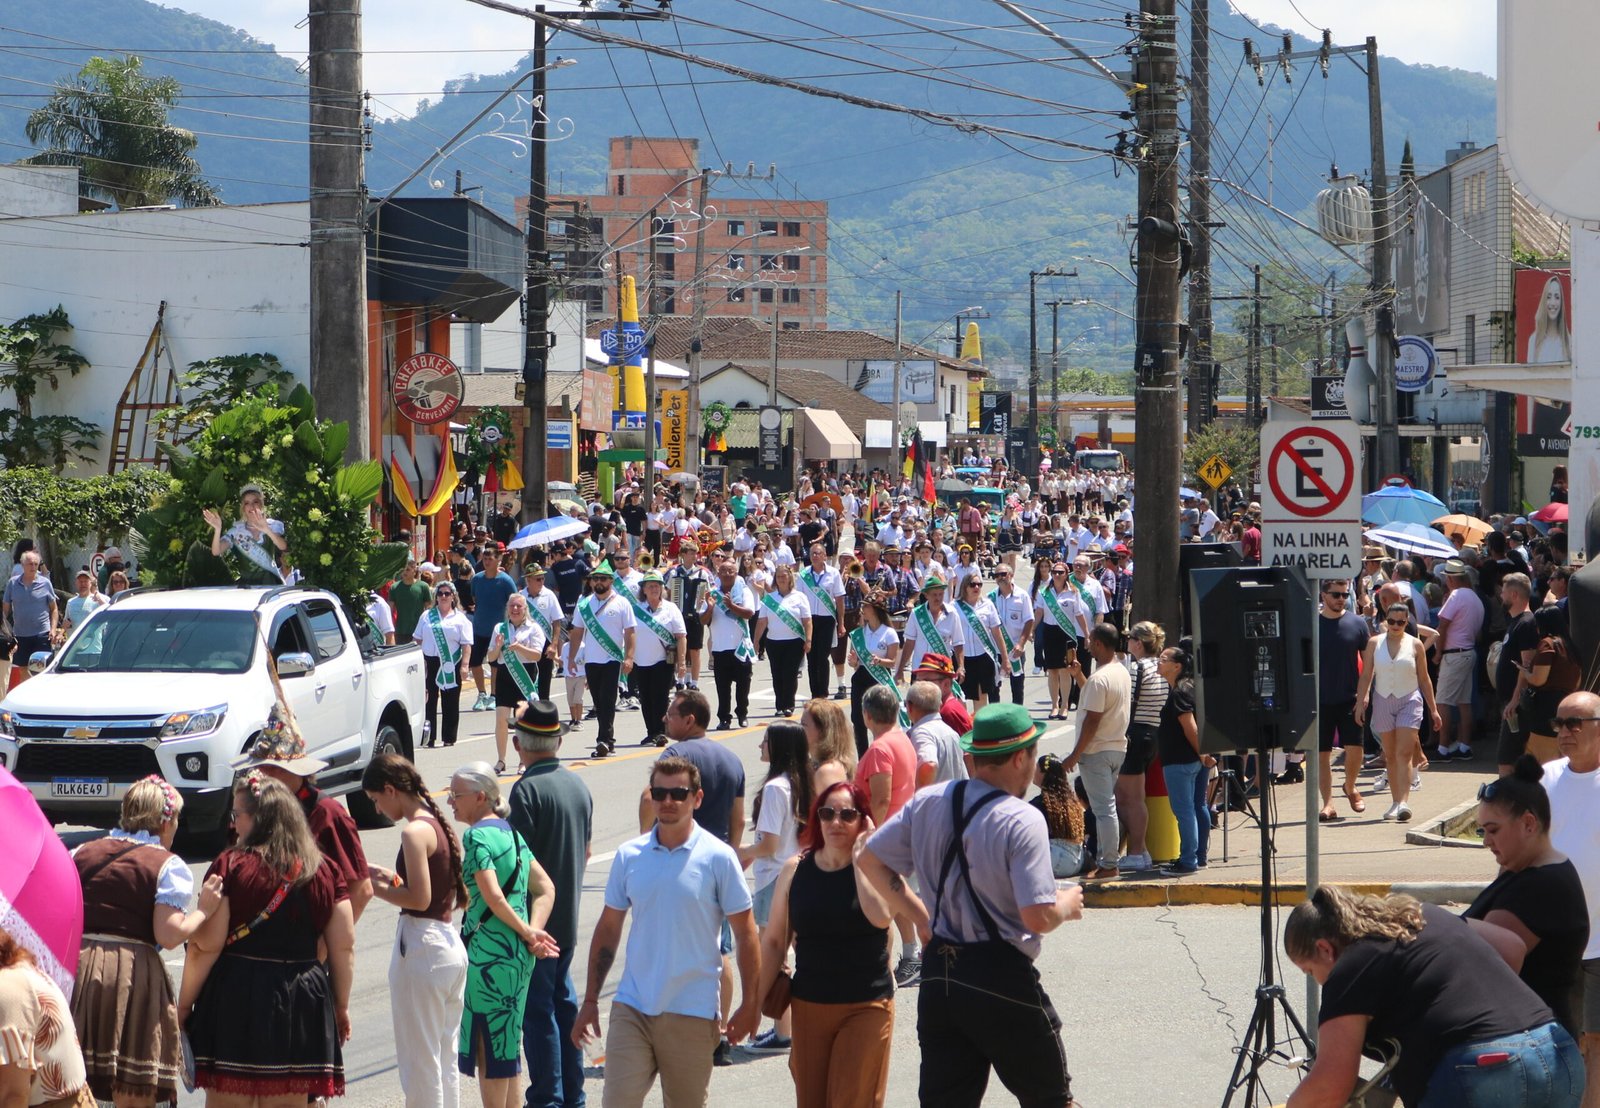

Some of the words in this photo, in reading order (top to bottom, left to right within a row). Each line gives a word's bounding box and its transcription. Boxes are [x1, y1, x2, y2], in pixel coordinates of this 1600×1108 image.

[395, 355, 452, 390] CHEROKEE
[1395, 365, 1424, 373] MAESTRO
[415, 399, 456, 420] CERVEJARIA
[1574, 426, 1600, 438] 793
[1273, 533, 1296, 548] NA
[1300, 533, 1350, 548] LINHA
[1271, 553, 1352, 569] AMARELA
[57, 784, 103, 795] RLK6E49
